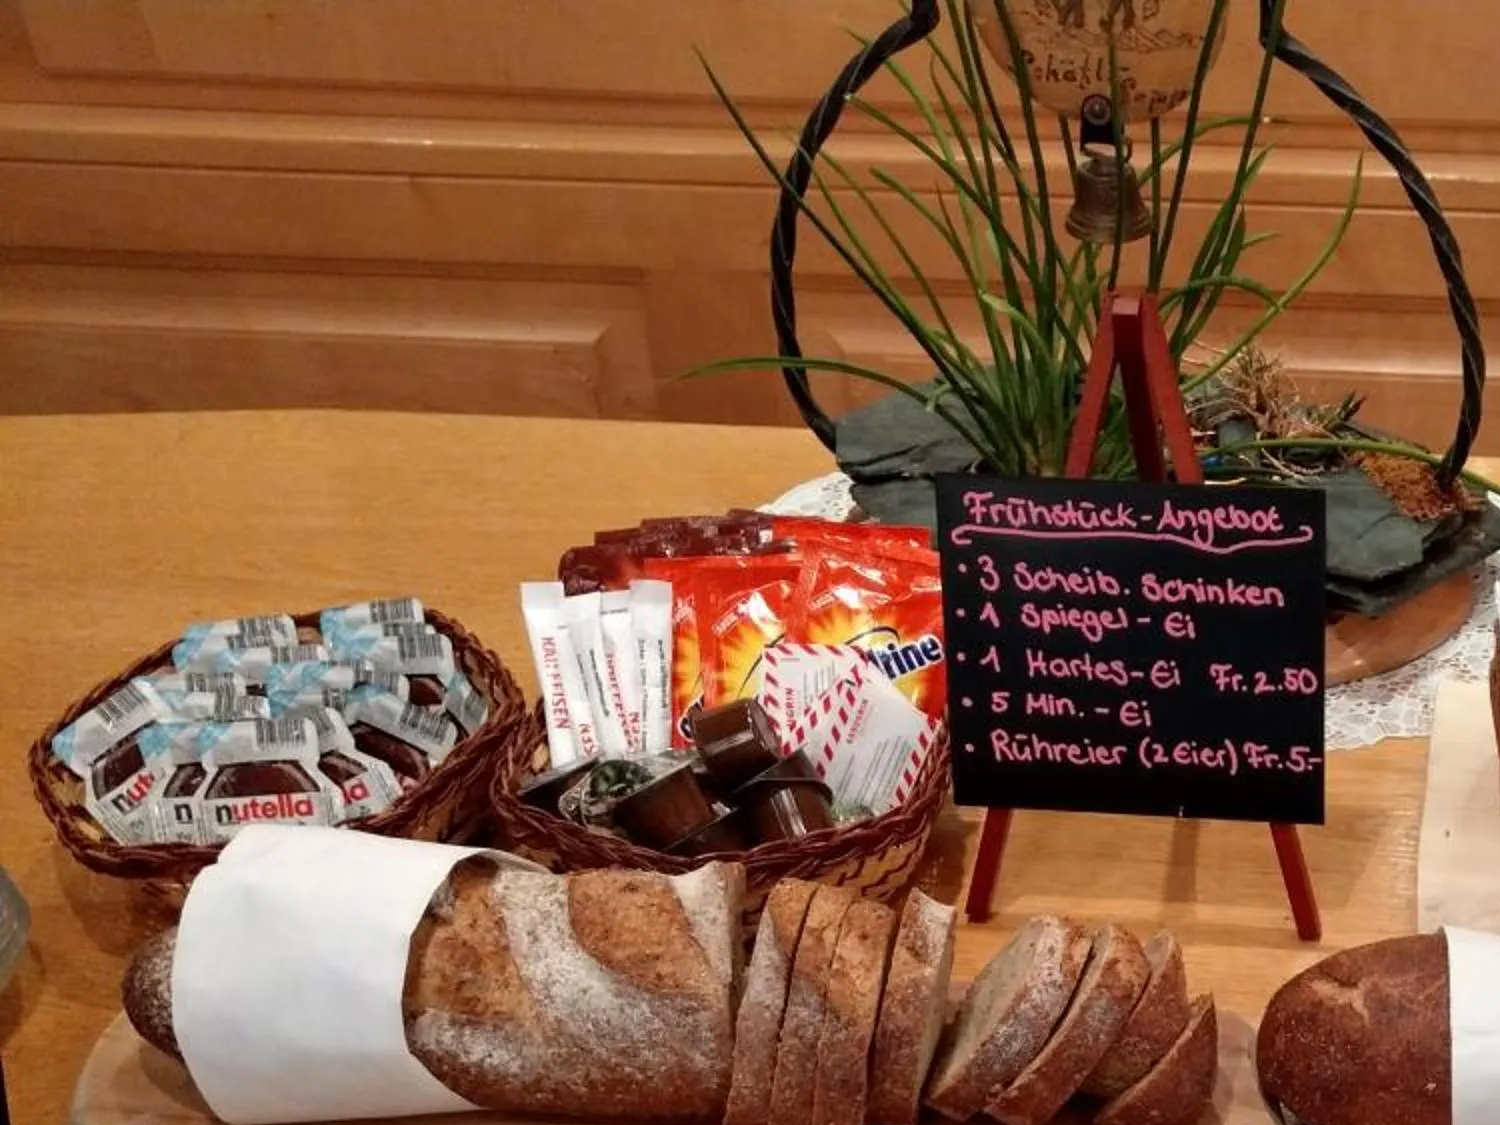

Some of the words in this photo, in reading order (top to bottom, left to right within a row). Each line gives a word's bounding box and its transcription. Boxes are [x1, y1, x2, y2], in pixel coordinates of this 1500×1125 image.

[978, 556, 999, 591] 3
[1014, 562, 1129, 594] Scheib.
[1142, 574, 1284, 606] Schinken
[979, 604, 999, 628] 1
[980, 646, 999, 672] 1
[992, 692, 1009, 712] 5
[215, 794, 315, 825] nutella
